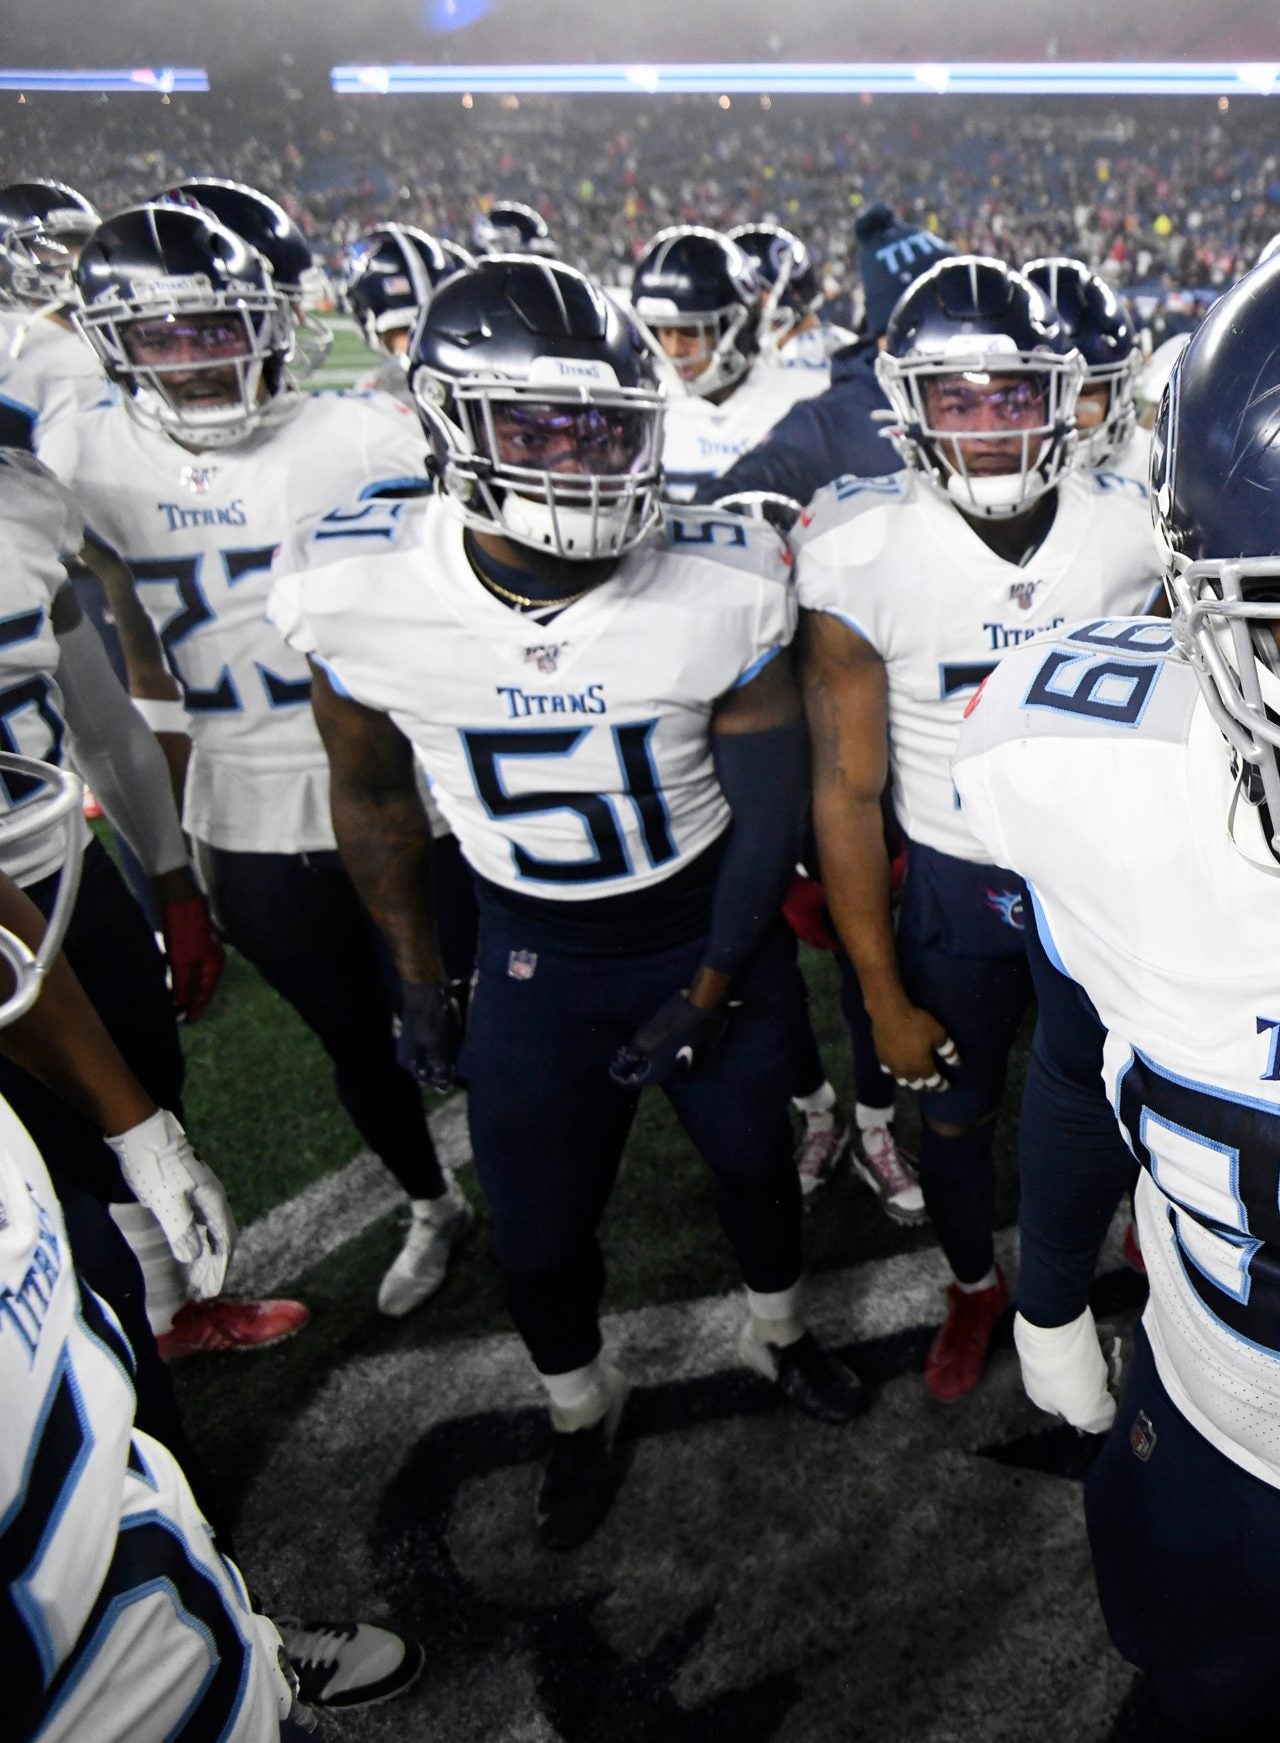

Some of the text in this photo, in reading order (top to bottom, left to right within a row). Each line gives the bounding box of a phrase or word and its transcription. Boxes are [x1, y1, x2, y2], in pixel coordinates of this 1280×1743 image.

[157, 499, 247, 532] TITANS
[983, 616, 1065, 651] TITA
[496, 684, 607, 719] TITANS
[457, 716, 680, 886] 51
